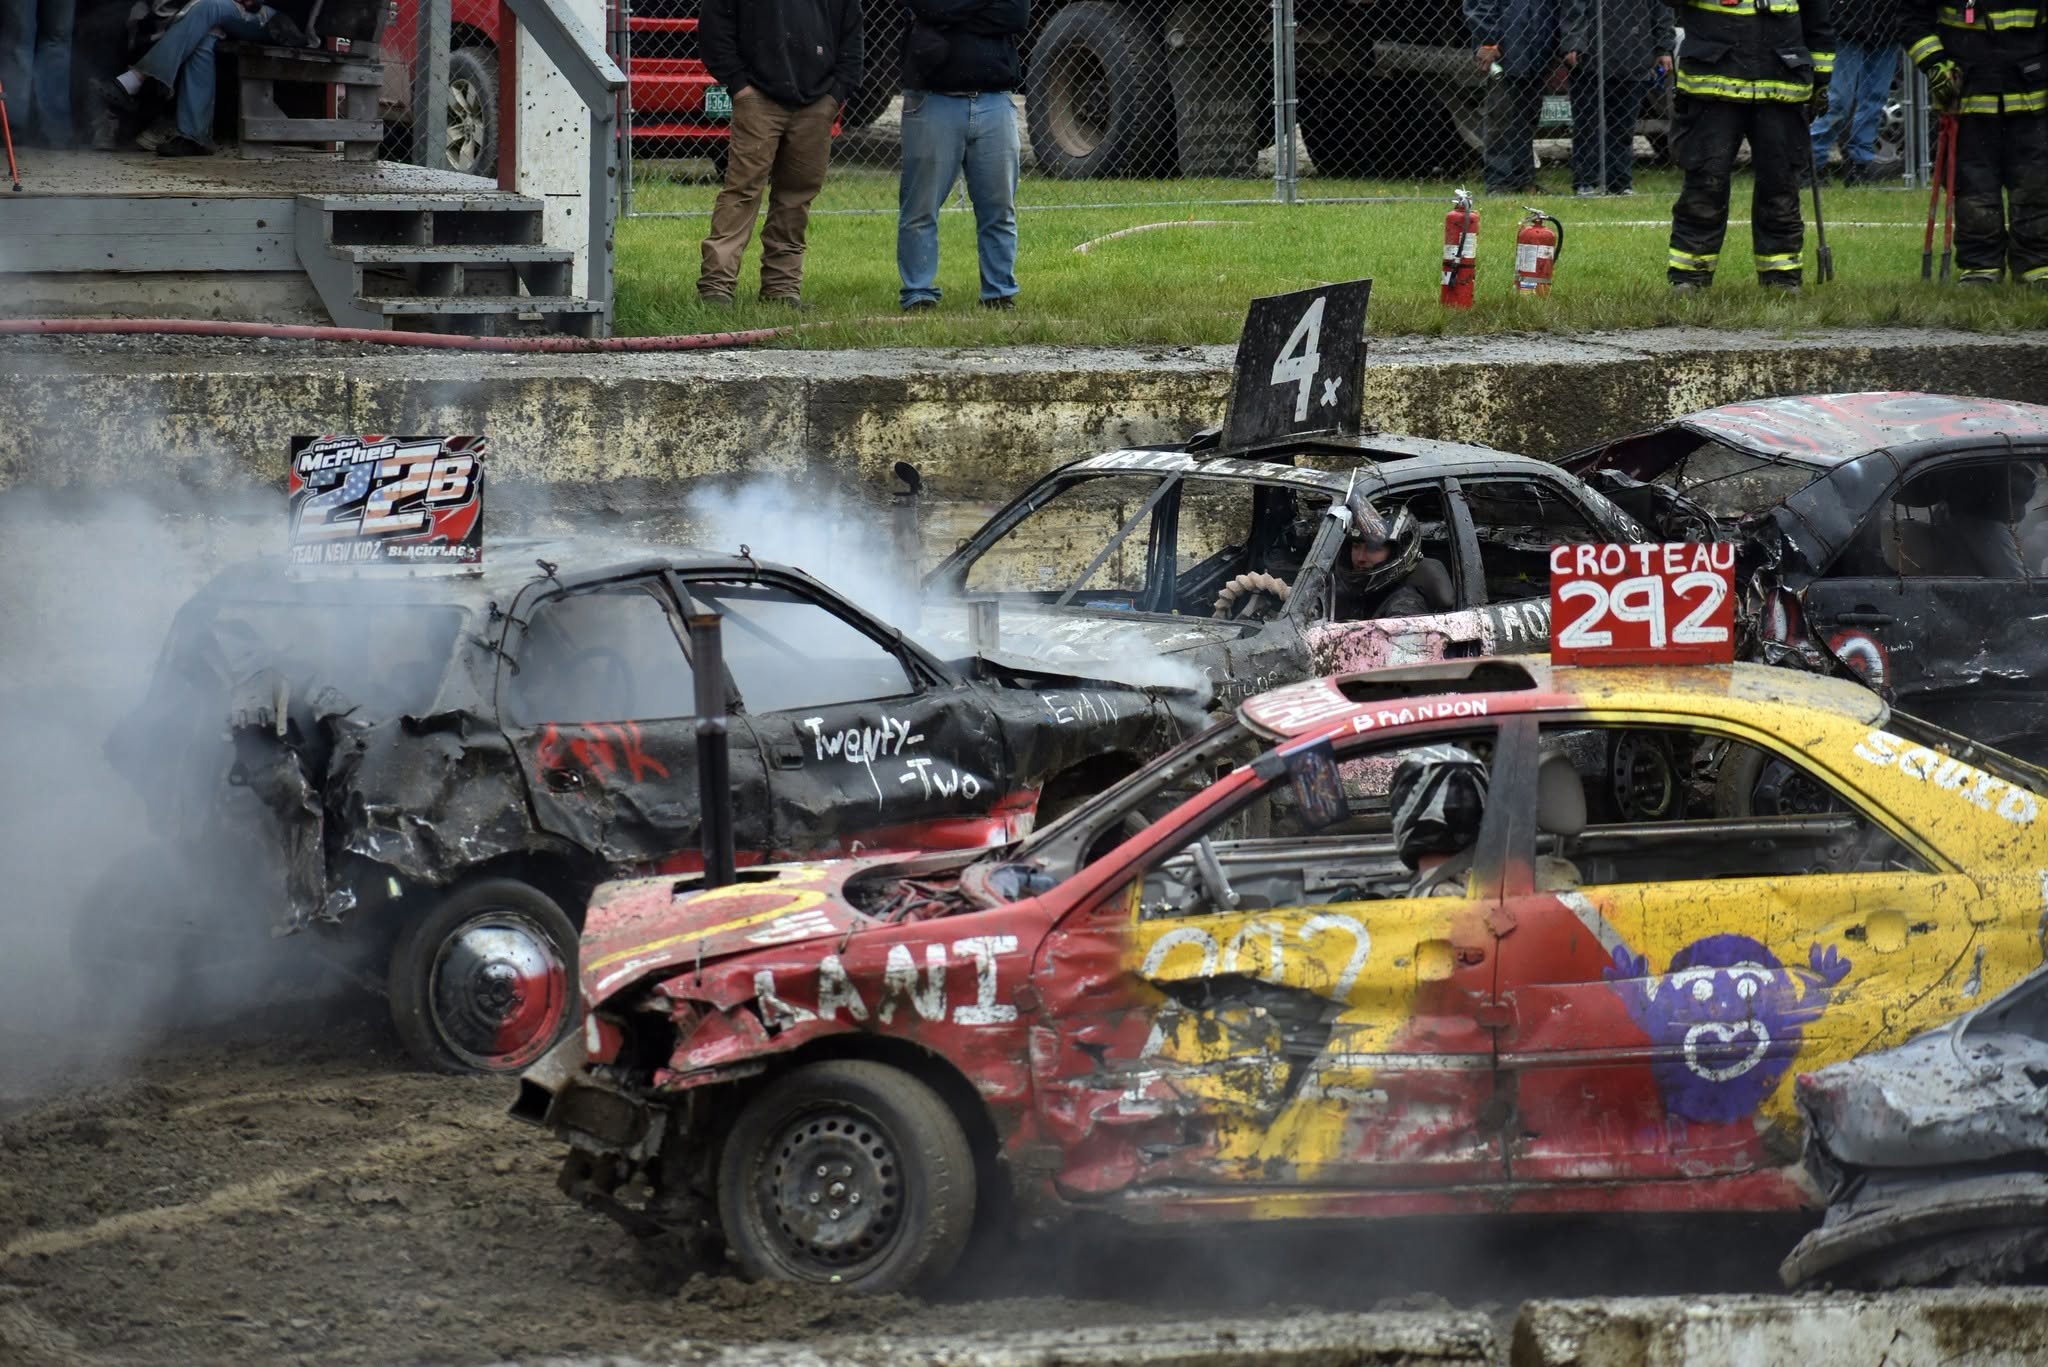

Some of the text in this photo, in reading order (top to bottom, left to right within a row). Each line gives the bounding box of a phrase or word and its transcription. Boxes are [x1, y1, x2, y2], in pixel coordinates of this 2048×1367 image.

[299, 444, 396, 472] McPhee
[299, 444, 474, 540] 22B
[292, 544, 323, 564] TEAM
[325, 543, 351, 563] NEW
[387, 545, 468, 558] BLACKFLAG
[1550, 543, 1736, 576] CROTEAU
[1558, 571, 1729, 649] 292
[1353, 698, 1489, 734] BRANDON
